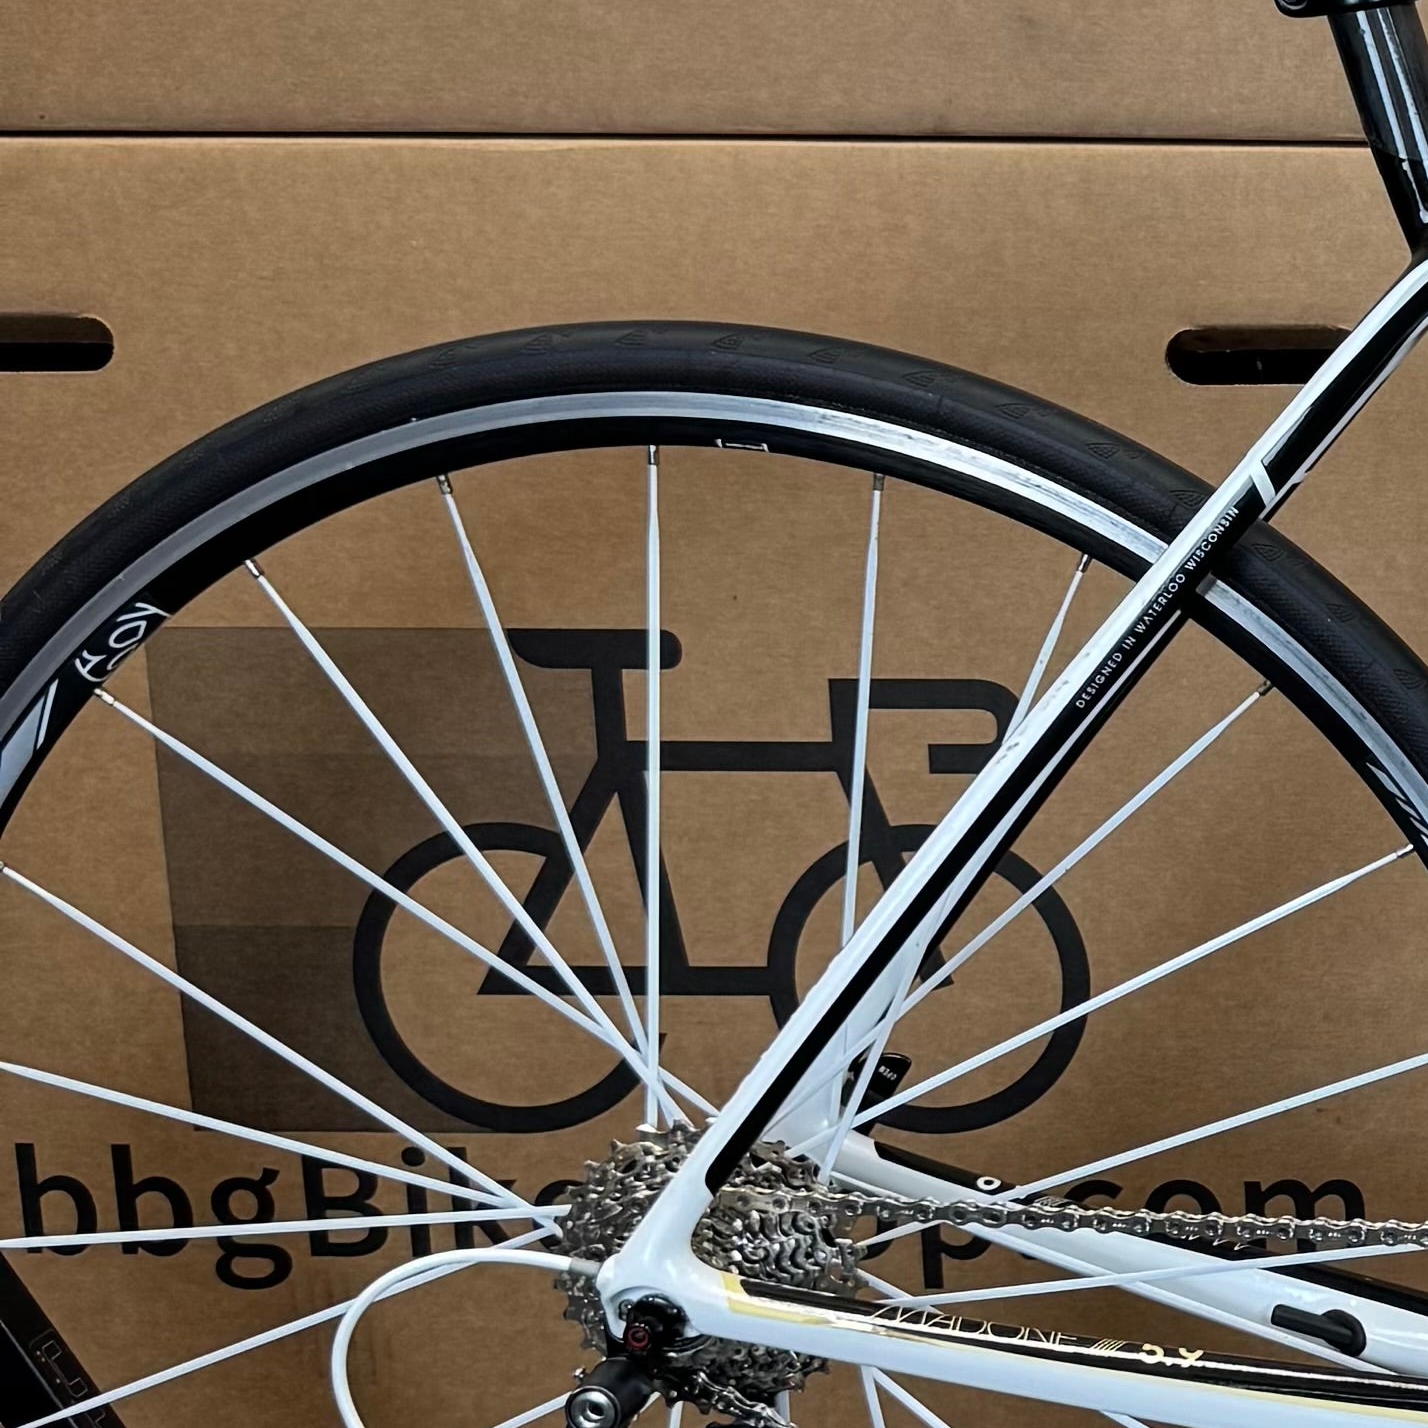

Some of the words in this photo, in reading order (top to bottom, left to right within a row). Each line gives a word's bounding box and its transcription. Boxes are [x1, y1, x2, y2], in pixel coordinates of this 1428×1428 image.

[1075, 652, 1124, 709] DESIGNED
[1121, 635, 1137, 651] IN
[1133, 572, 1187, 635] WATERLOO
[1184, 505, 1240, 572] WISCONSIN
